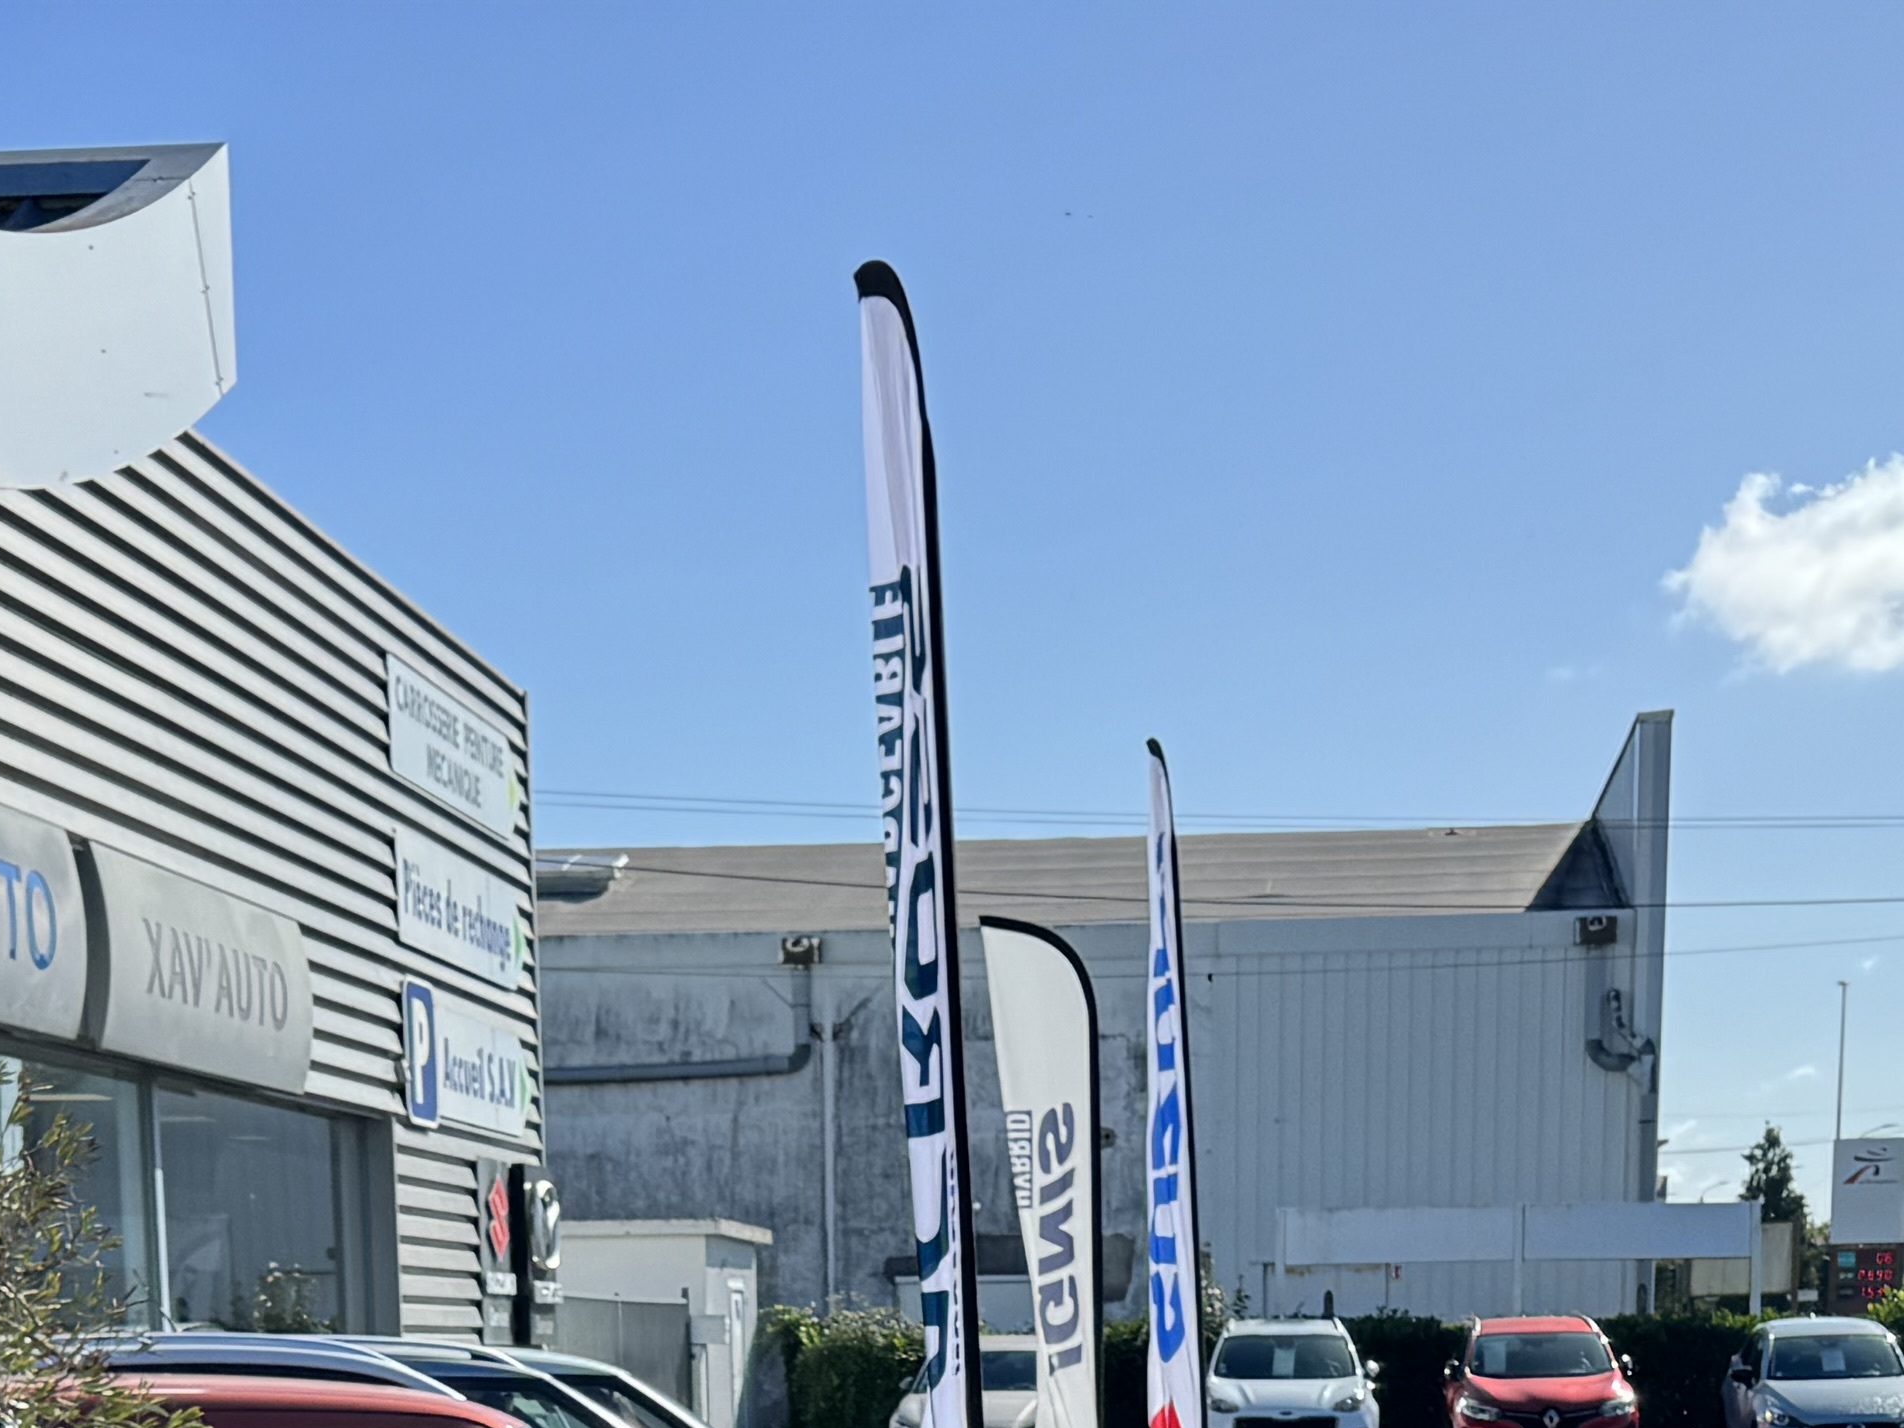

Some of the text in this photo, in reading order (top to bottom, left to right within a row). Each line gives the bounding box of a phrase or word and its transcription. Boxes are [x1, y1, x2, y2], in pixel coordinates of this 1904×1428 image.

[142, 916, 288, 1031] XAV'AUTO
[445, 879, 460, 938] de
[462, 895, 511, 971] rechange
[411, 997, 430, 1104] P
[443, 1037, 485, 1100] Accueil
